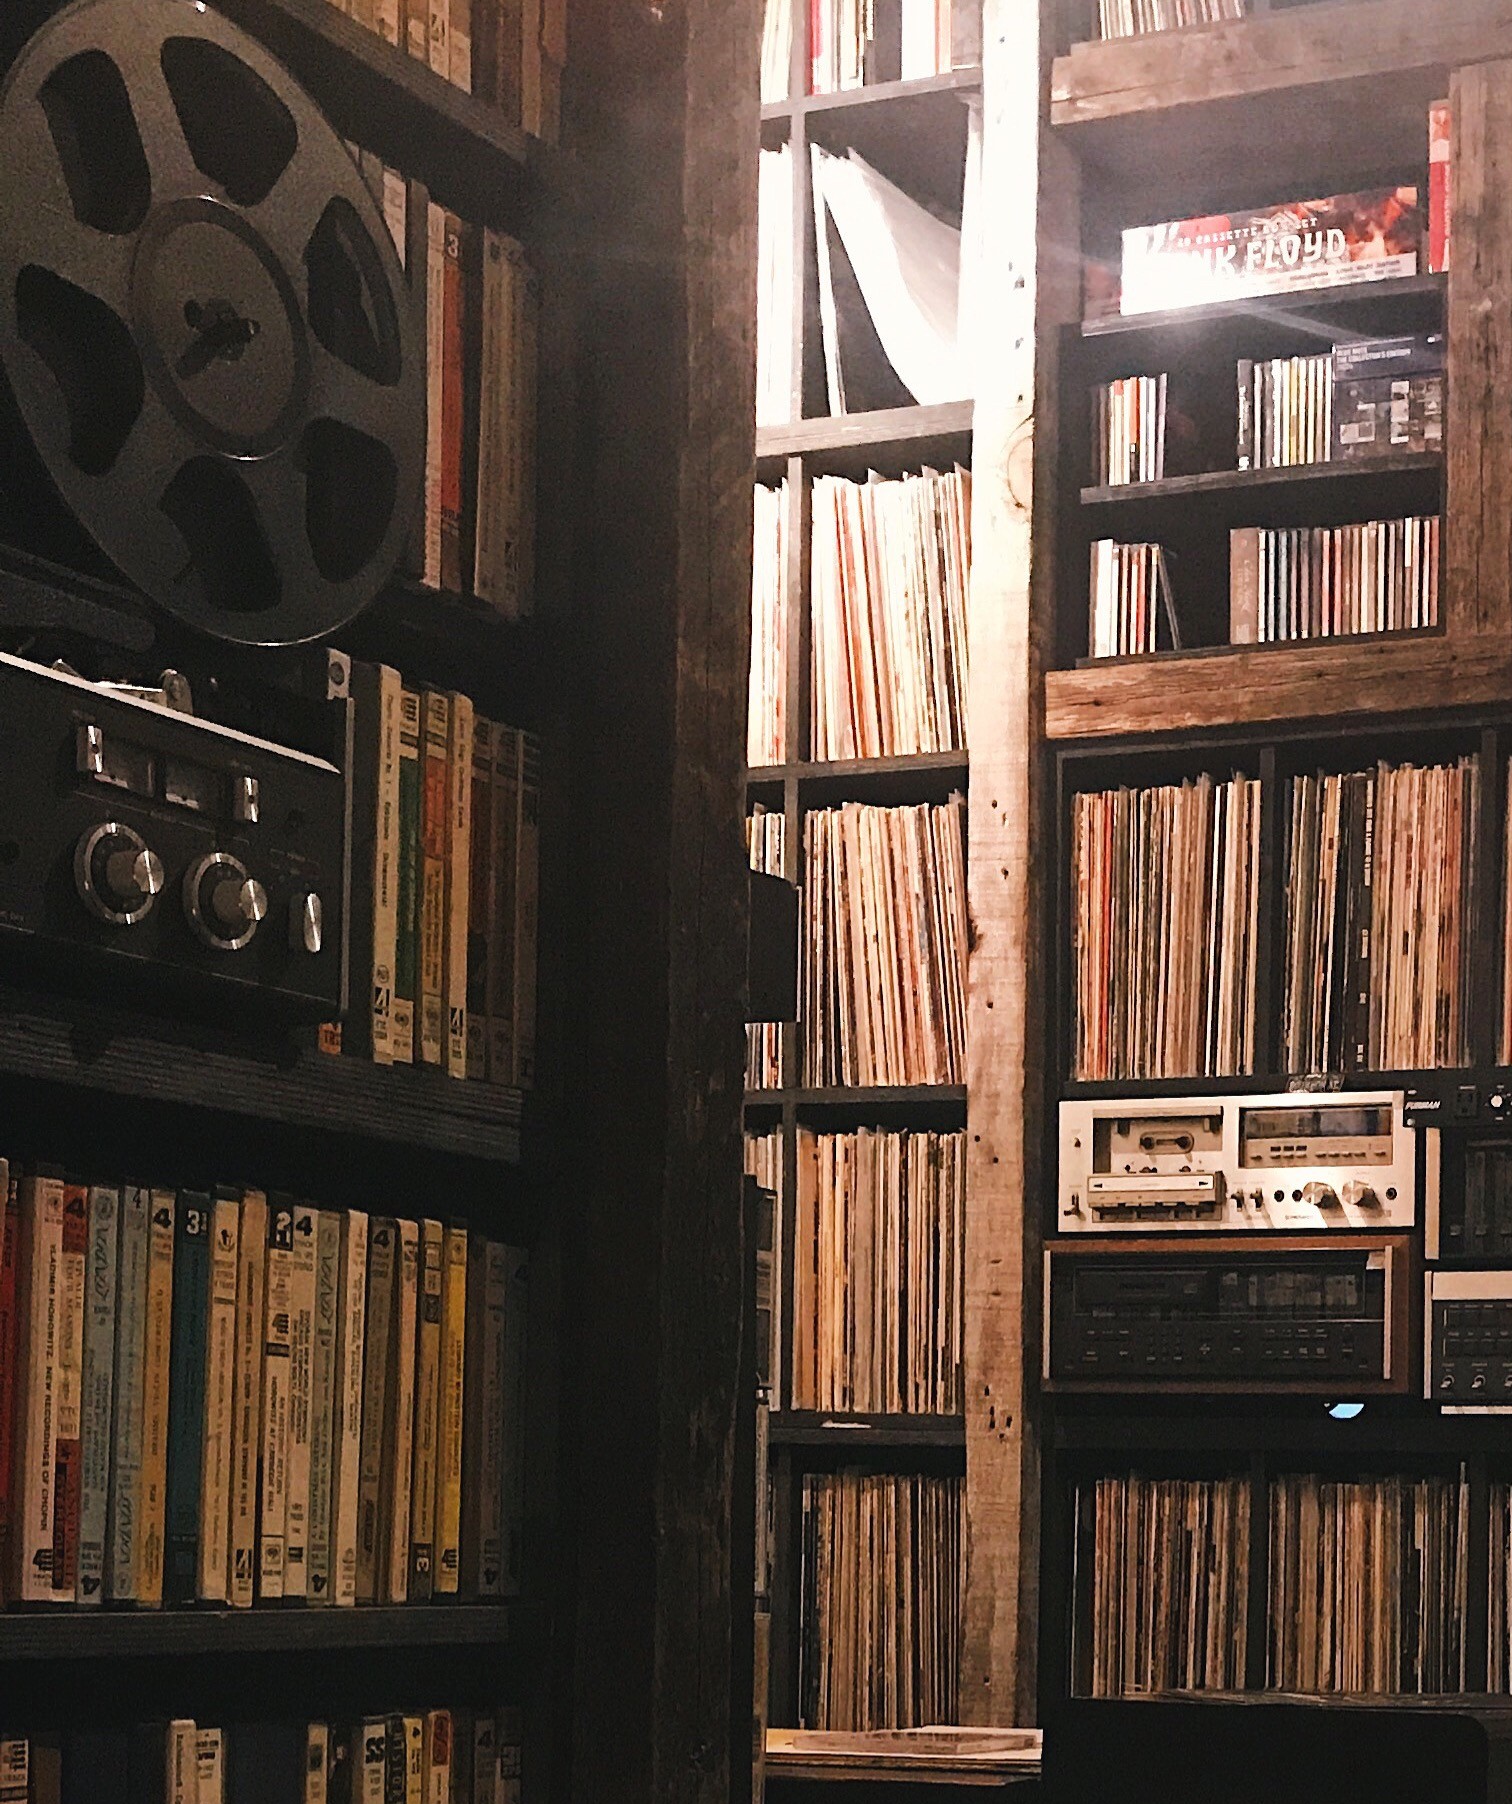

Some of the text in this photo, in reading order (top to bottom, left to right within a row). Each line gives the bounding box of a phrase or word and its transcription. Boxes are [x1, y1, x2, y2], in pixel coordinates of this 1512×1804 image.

[1195, 224, 1258, 246] CASSETTE
[1244, 227, 1349, 273] FLOYD
[132, 1187, 143, 1209] 4
[153, 1207, 171, 1229] 4
[296, 1215, 313, 1236] 4
[373, 1229, 391, 1248] 4
[48, 1244, 58, 1295] VLADIMIR
[44, 1365, 55, 1390] NEW
[42, 1393, 53, 1467] RECORDINGS
[41, 1470, 50, 1485] OF
[40, 1488, 50, 1531] CHOPIN
[80, 1576, 101, 1596] 4
[313, 1574, 328, 1593] 4
[412, 1727, 422, 1738] 4
